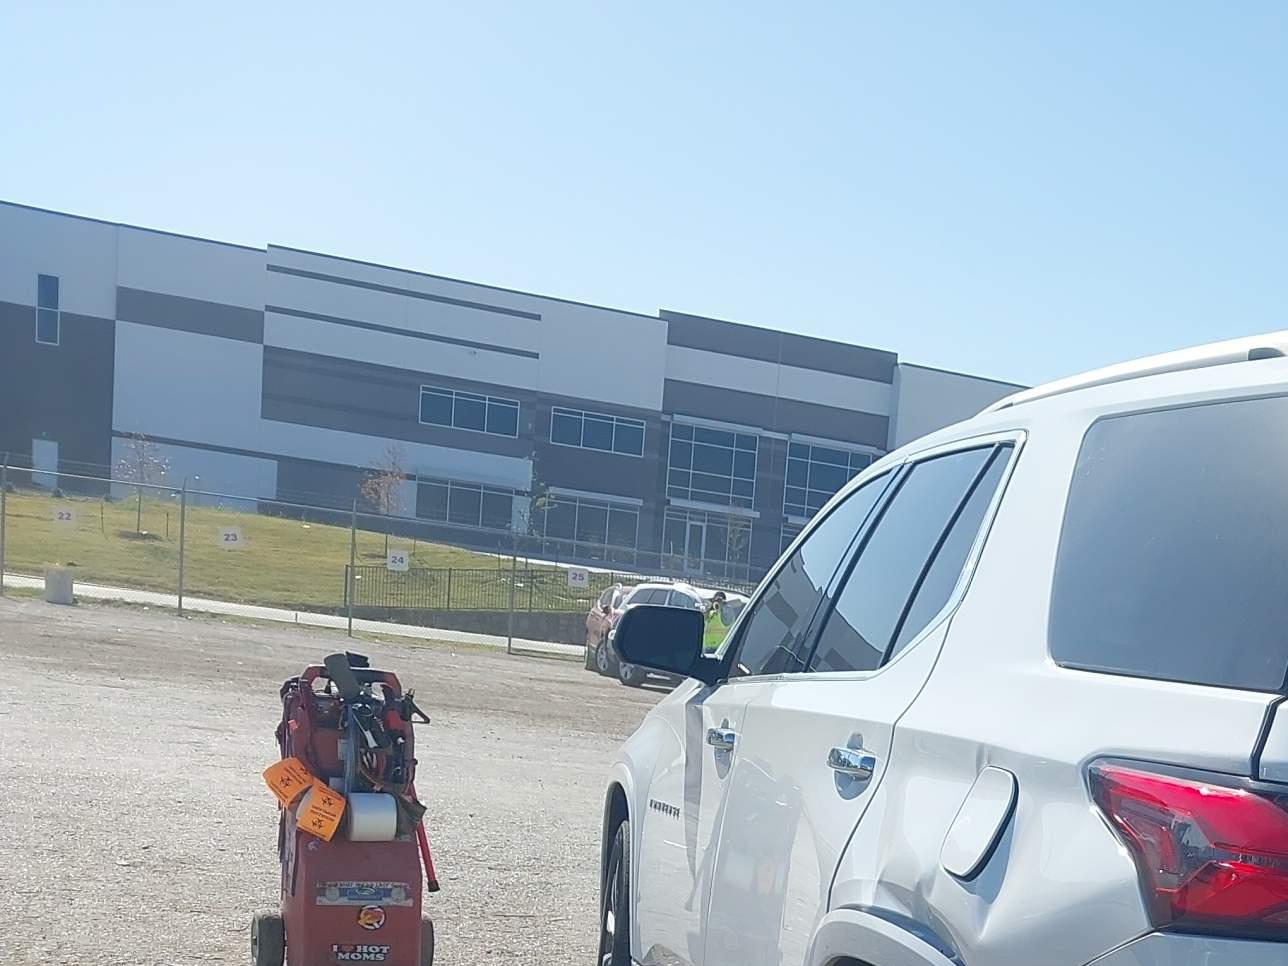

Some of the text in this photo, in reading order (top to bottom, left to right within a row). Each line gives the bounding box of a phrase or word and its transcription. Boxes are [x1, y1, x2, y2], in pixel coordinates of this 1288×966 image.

[56, 511, 72, 521] 22
[223, 532, 238, 542] 23
[391, 555, 405, 565] 24
[571, 572, 585, 582] 25
[356, 945, 390, 954] HOT
[337, 953, 385, 961] MOMS
